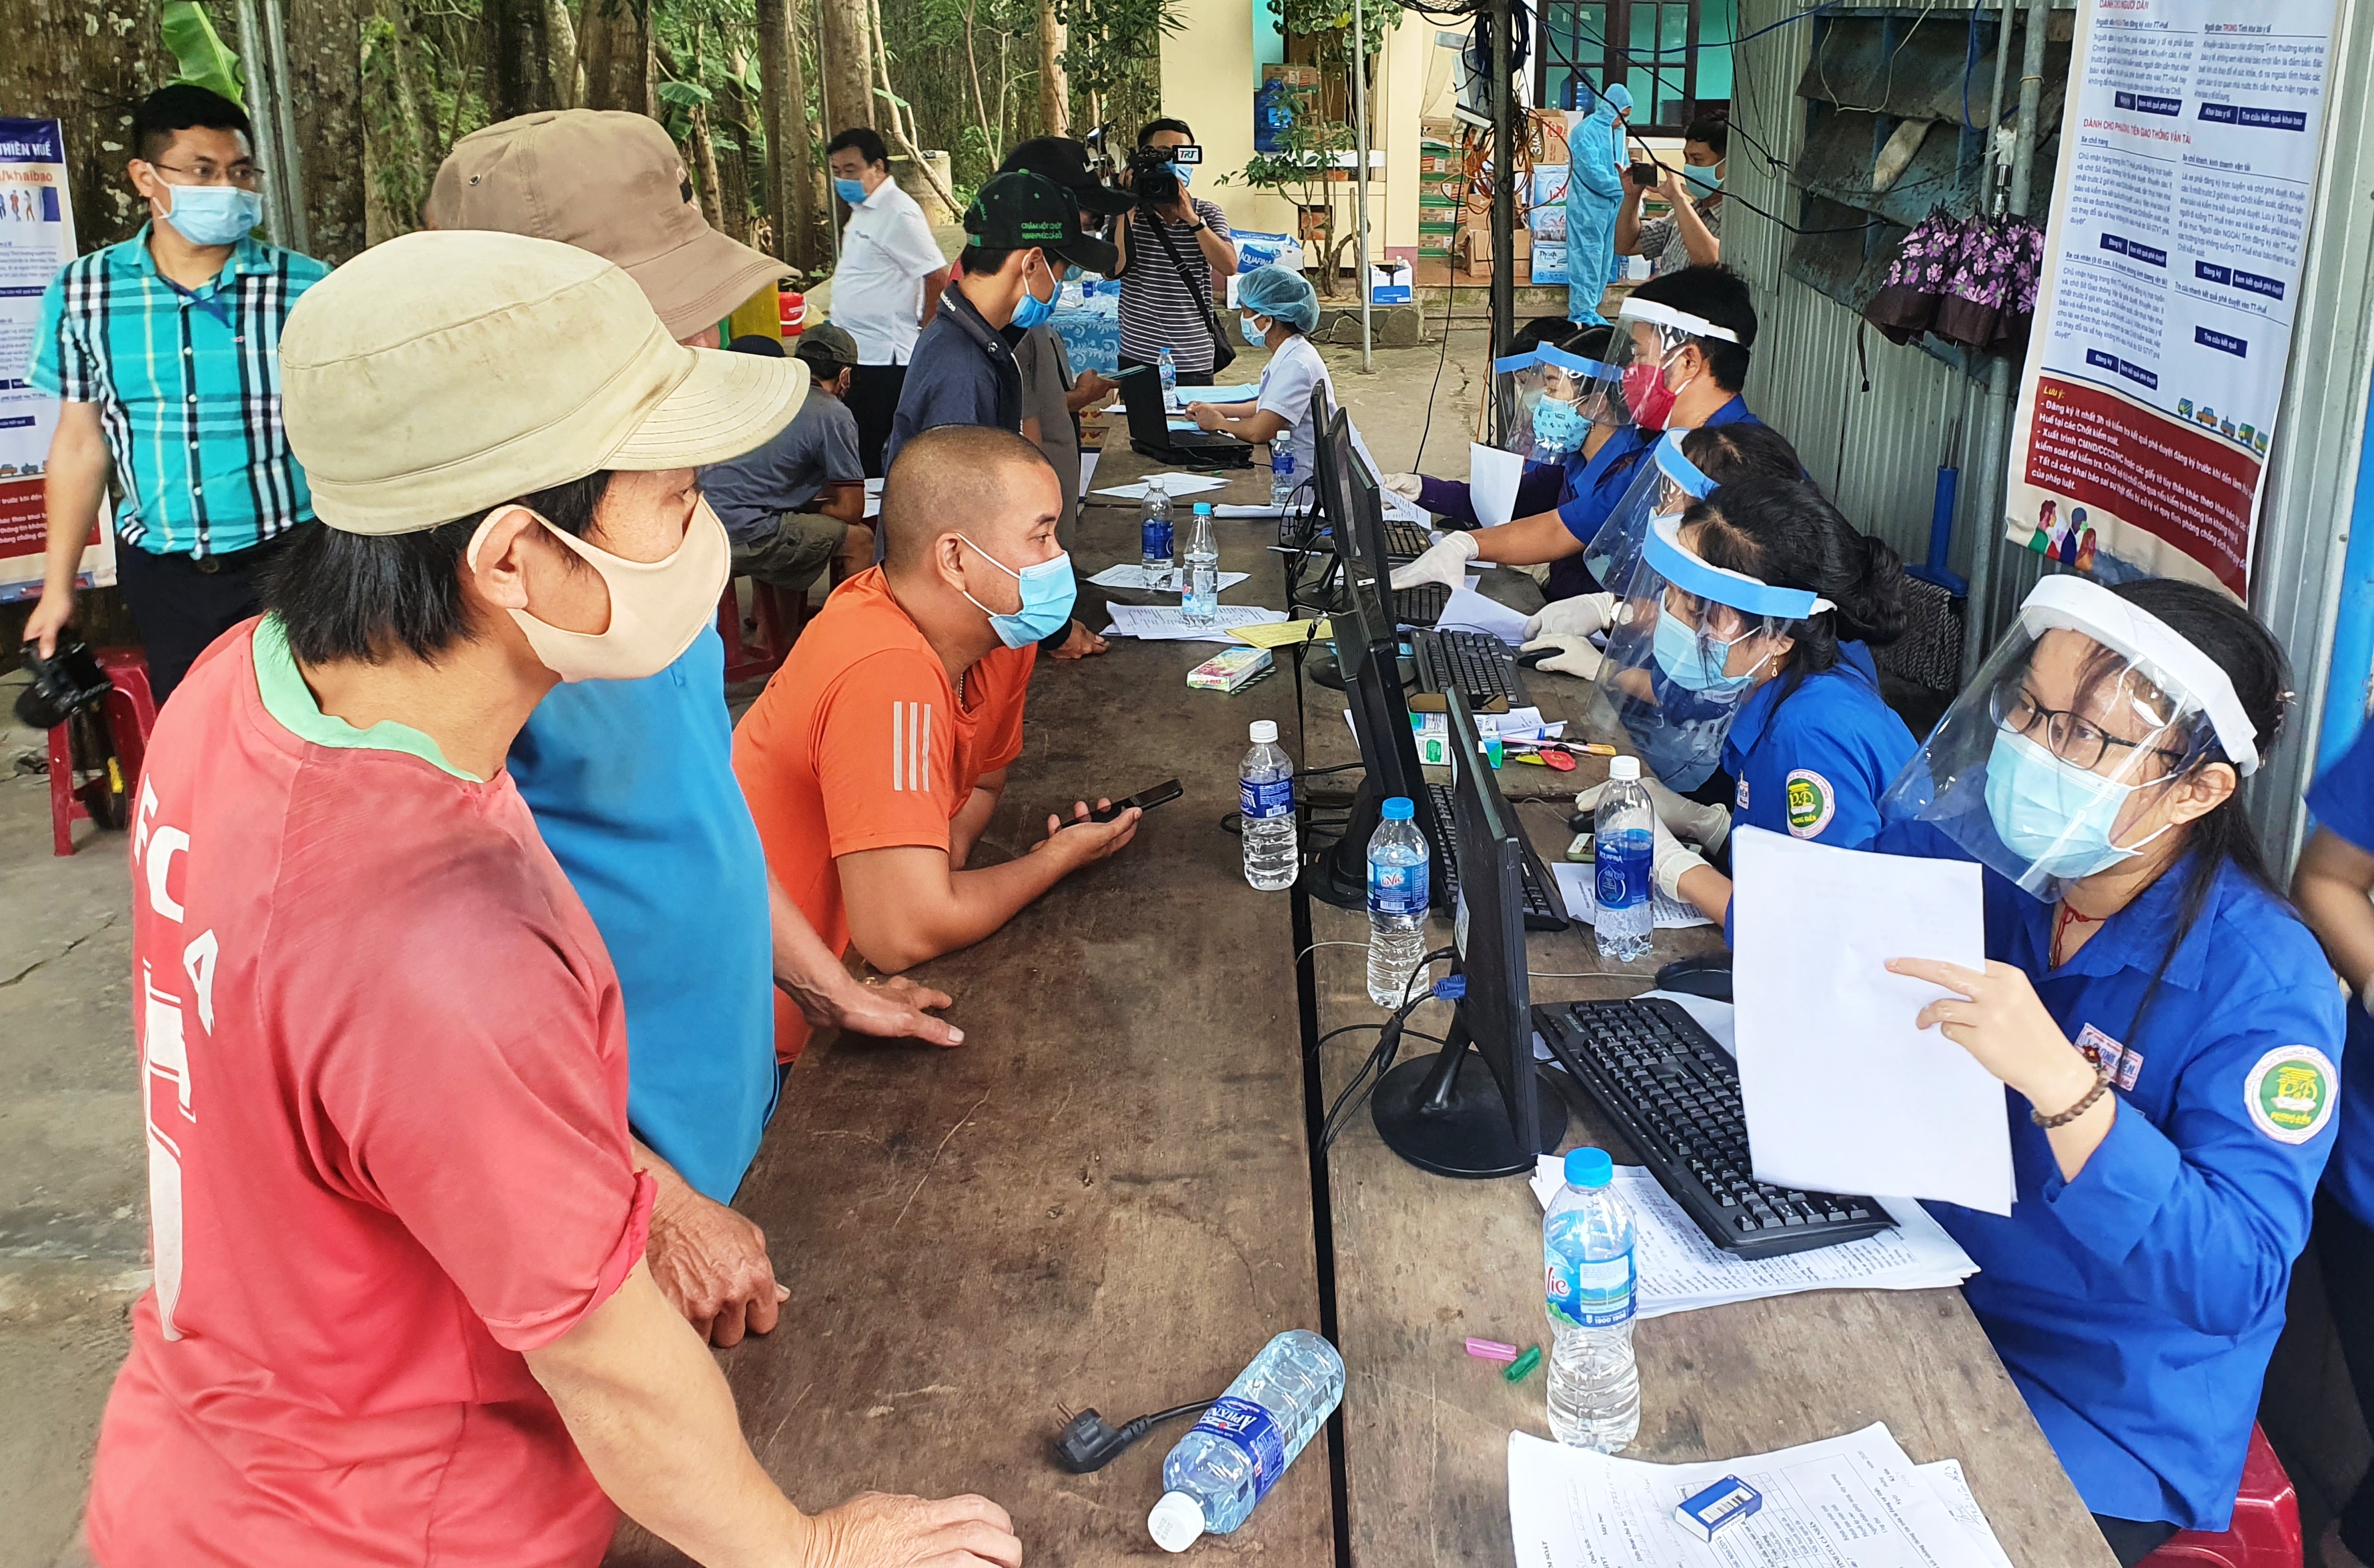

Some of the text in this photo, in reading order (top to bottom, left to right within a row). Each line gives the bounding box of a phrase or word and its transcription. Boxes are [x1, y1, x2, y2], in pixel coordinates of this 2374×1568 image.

[1179, 150, 1197, 159] TRT
[2046, 400, 2064, 415] Đăng
[2066, 405, 2074, 417] ký
[2039, 413, 2054, 424] Huế
[2054, 416, 2063, 427] tại
[2064, 420, 2076, 430] các
[2076, 424, 2092, 436] Chốt
[2042, 428, 2059, 440] Xuất
[2035, 440, 2053, 452] kiểm
[2053, 447, 2068, 457] soát
[2032, 468, 2044, 479] của
[2045, 473, 2061, 486] pháp
[2059, 462, 2071, 473] các
[2072, 466, 2087, 478] khai
[2088, 471, 2099, 483] báo
